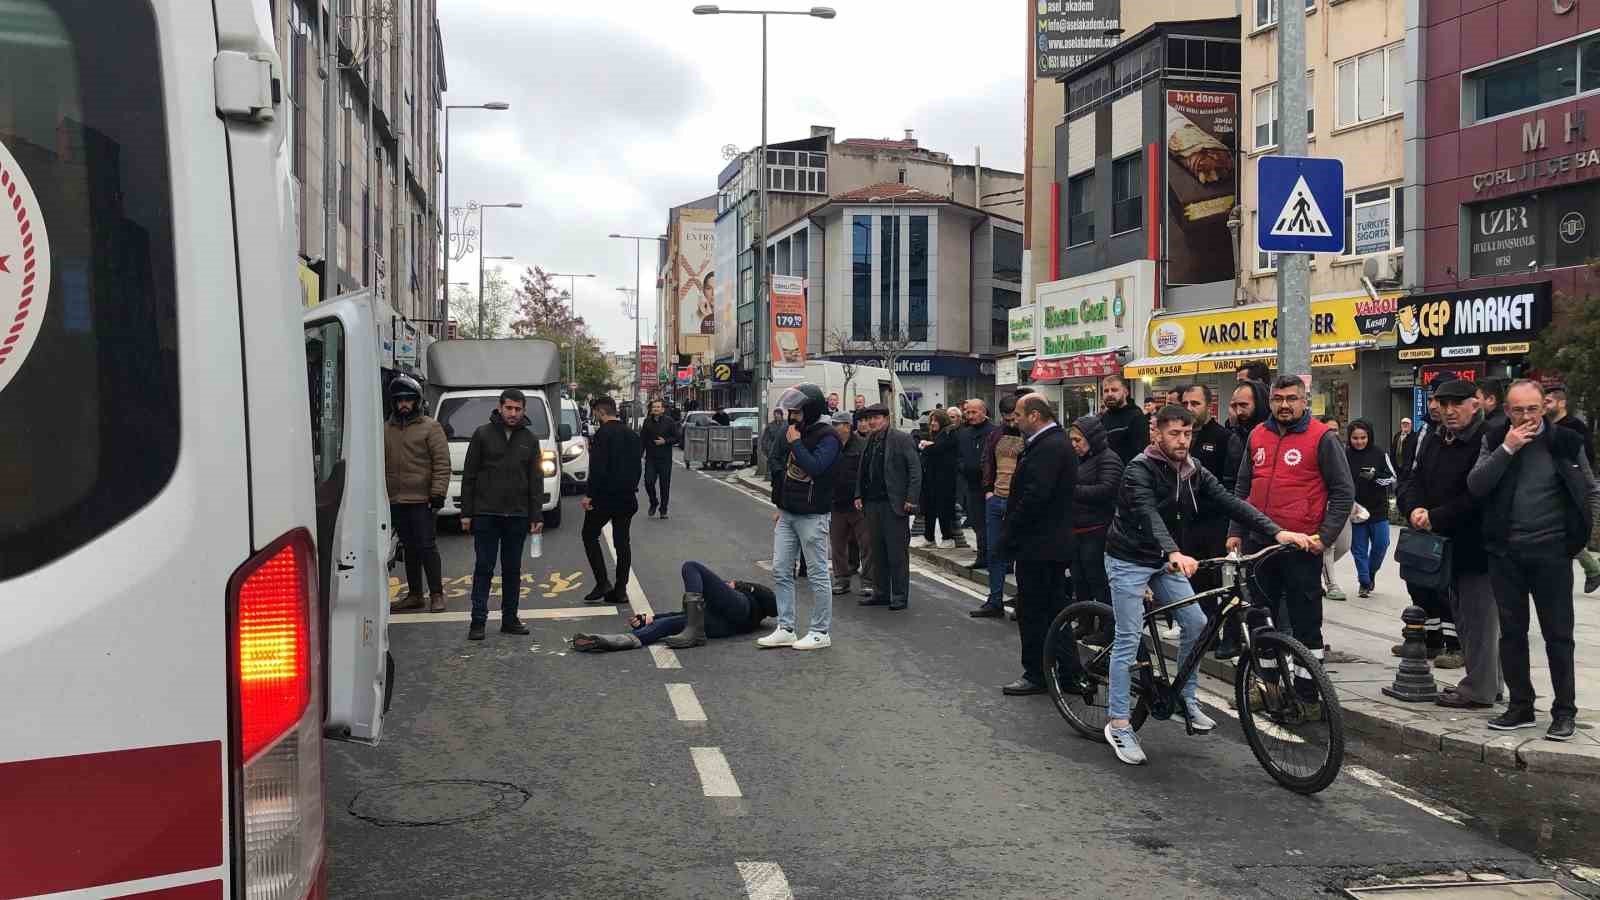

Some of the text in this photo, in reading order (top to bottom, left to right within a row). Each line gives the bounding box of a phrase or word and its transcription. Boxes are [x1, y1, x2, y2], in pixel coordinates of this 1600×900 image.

[1048, 17, 1119, 32] info@aselakademi.com
[1177, 92, 1194, 103] hot
[1419, 293, 1535, 338] CEP MARKET
[1365, 317, 1388, 330] Kasap
[1199, 320, 1248, 345] VAROL
[1253, 319, 1269, 340] ET
[1137, 367, 1158, 376] VAROL
[1213, 360, 1238, 371] VAROL
